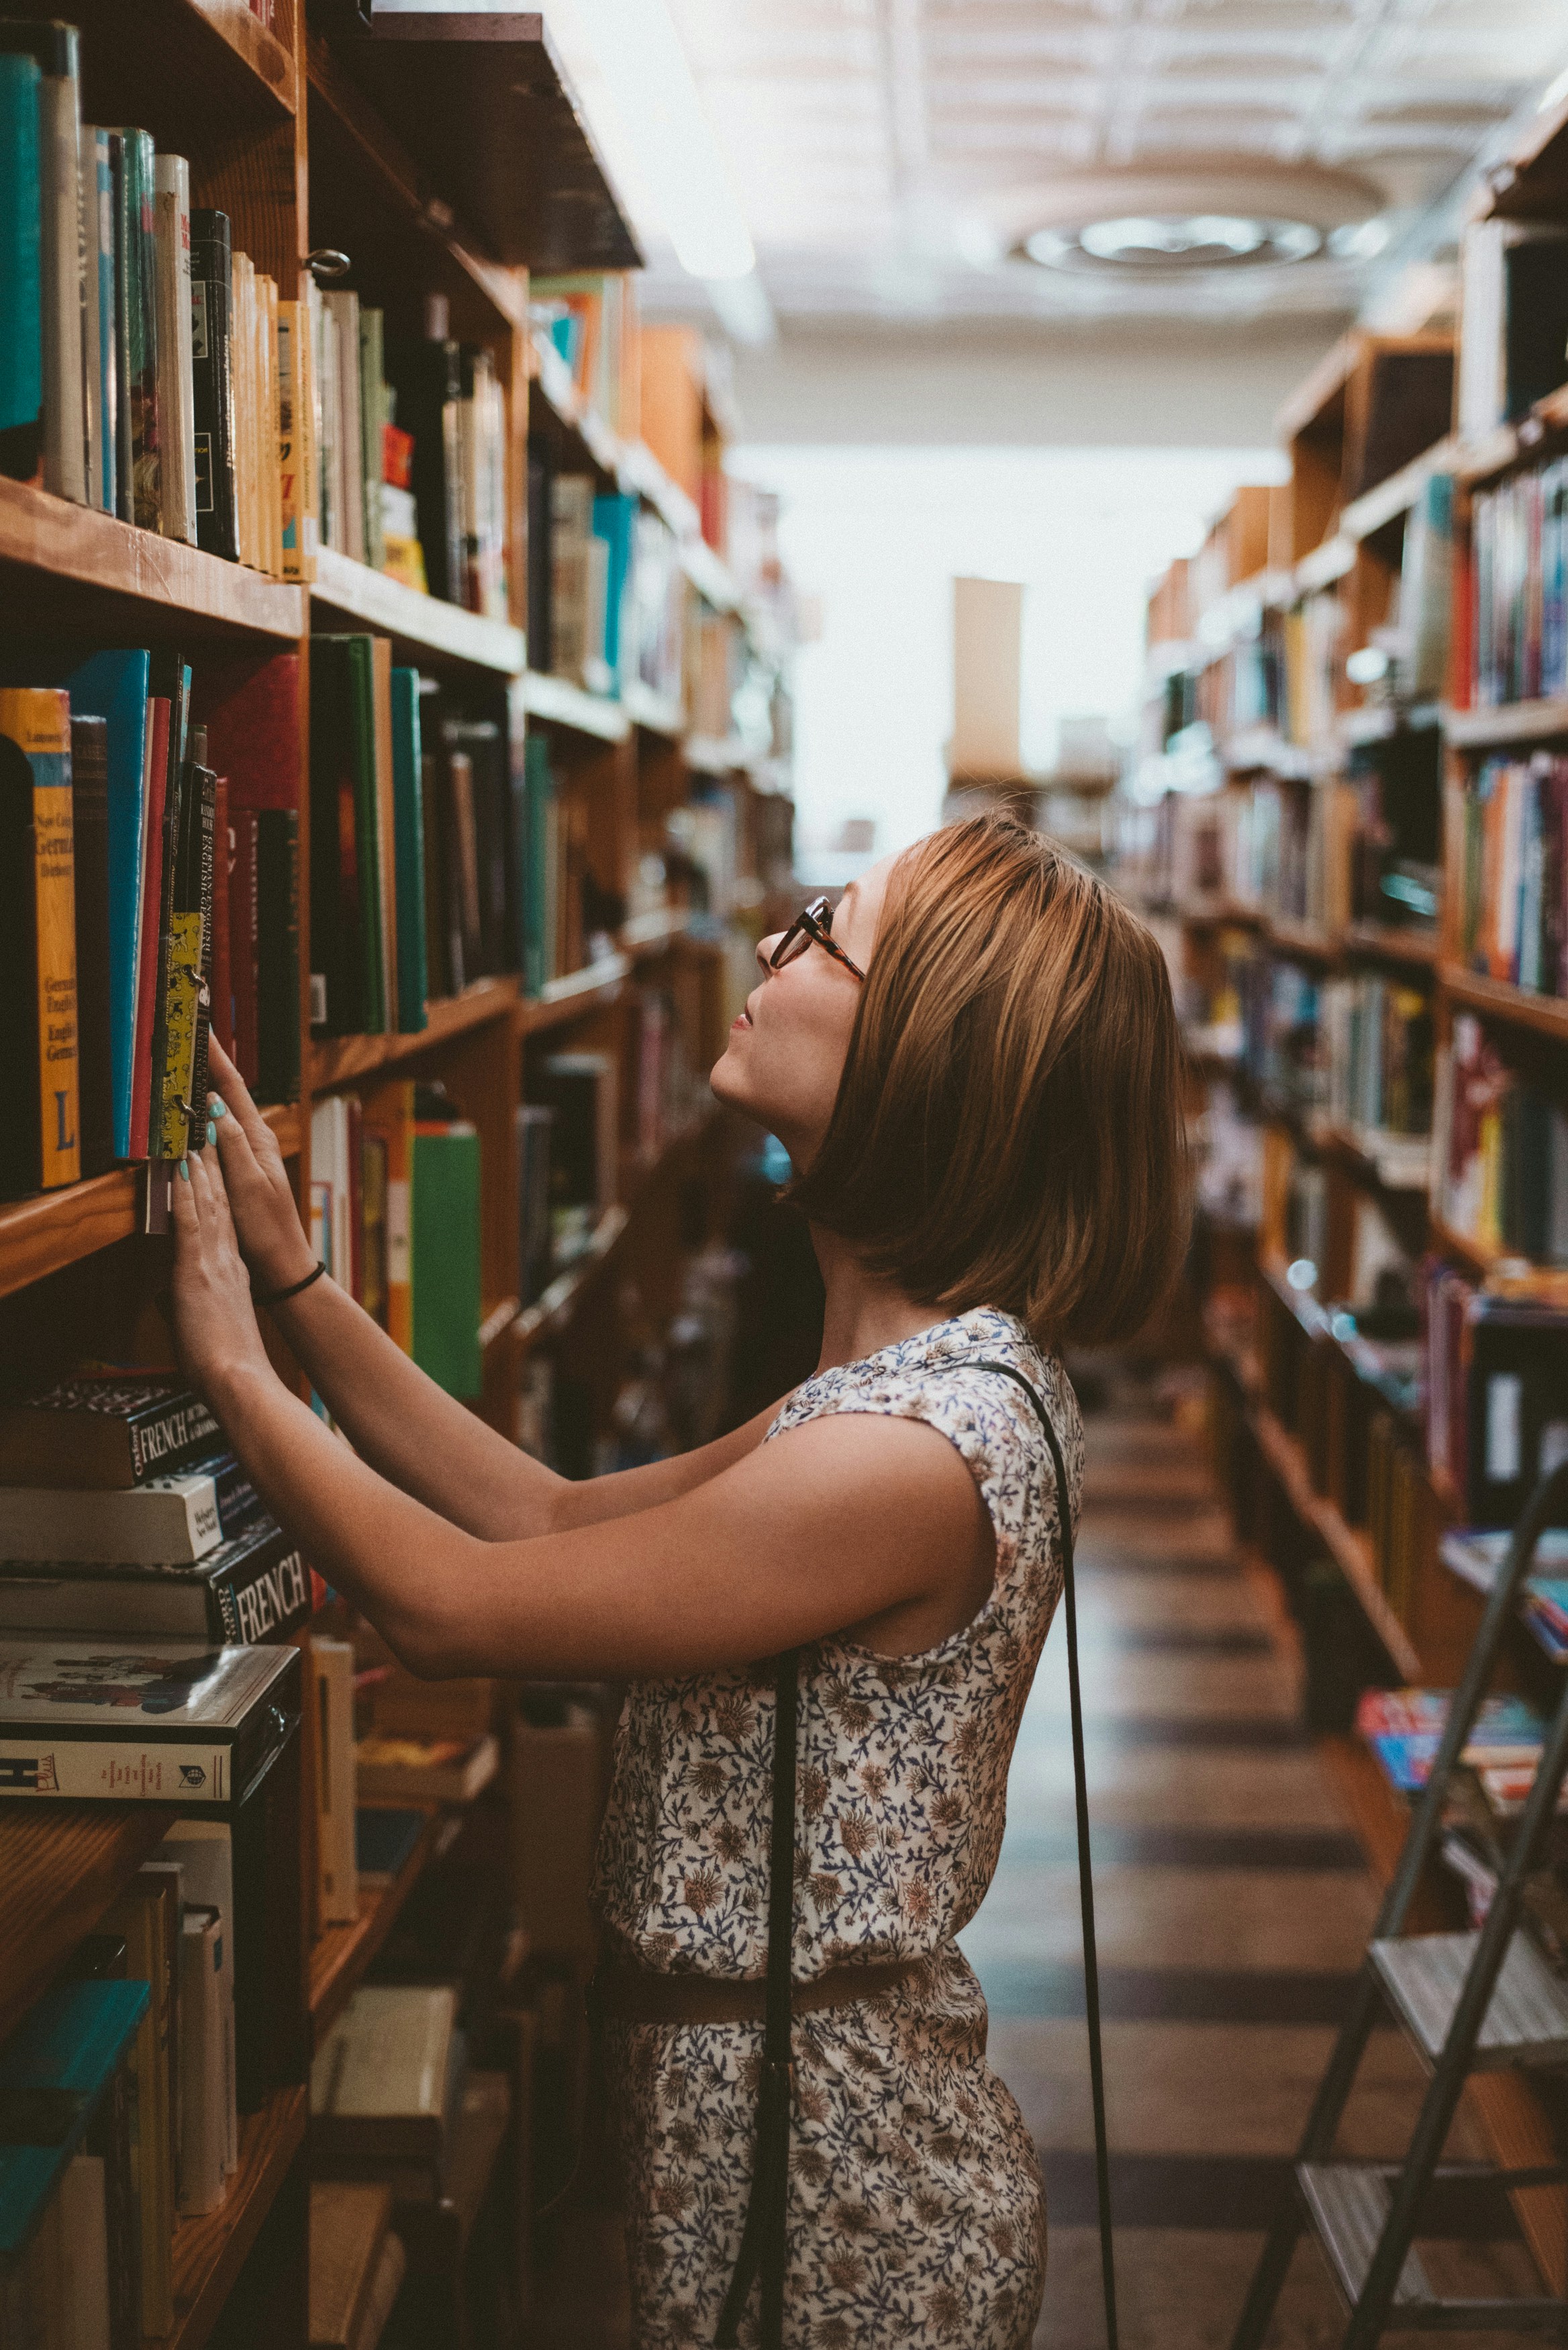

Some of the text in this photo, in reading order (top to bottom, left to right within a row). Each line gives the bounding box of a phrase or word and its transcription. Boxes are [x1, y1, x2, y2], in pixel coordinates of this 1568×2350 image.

[205, 836, 213, 951] GERMAN-ENGLISH
[140, 1411, 189, 1464] FRENCH
[236, 1550, 306, 1645] FRENCH
[34, 1754, 56, 1792] Plus
